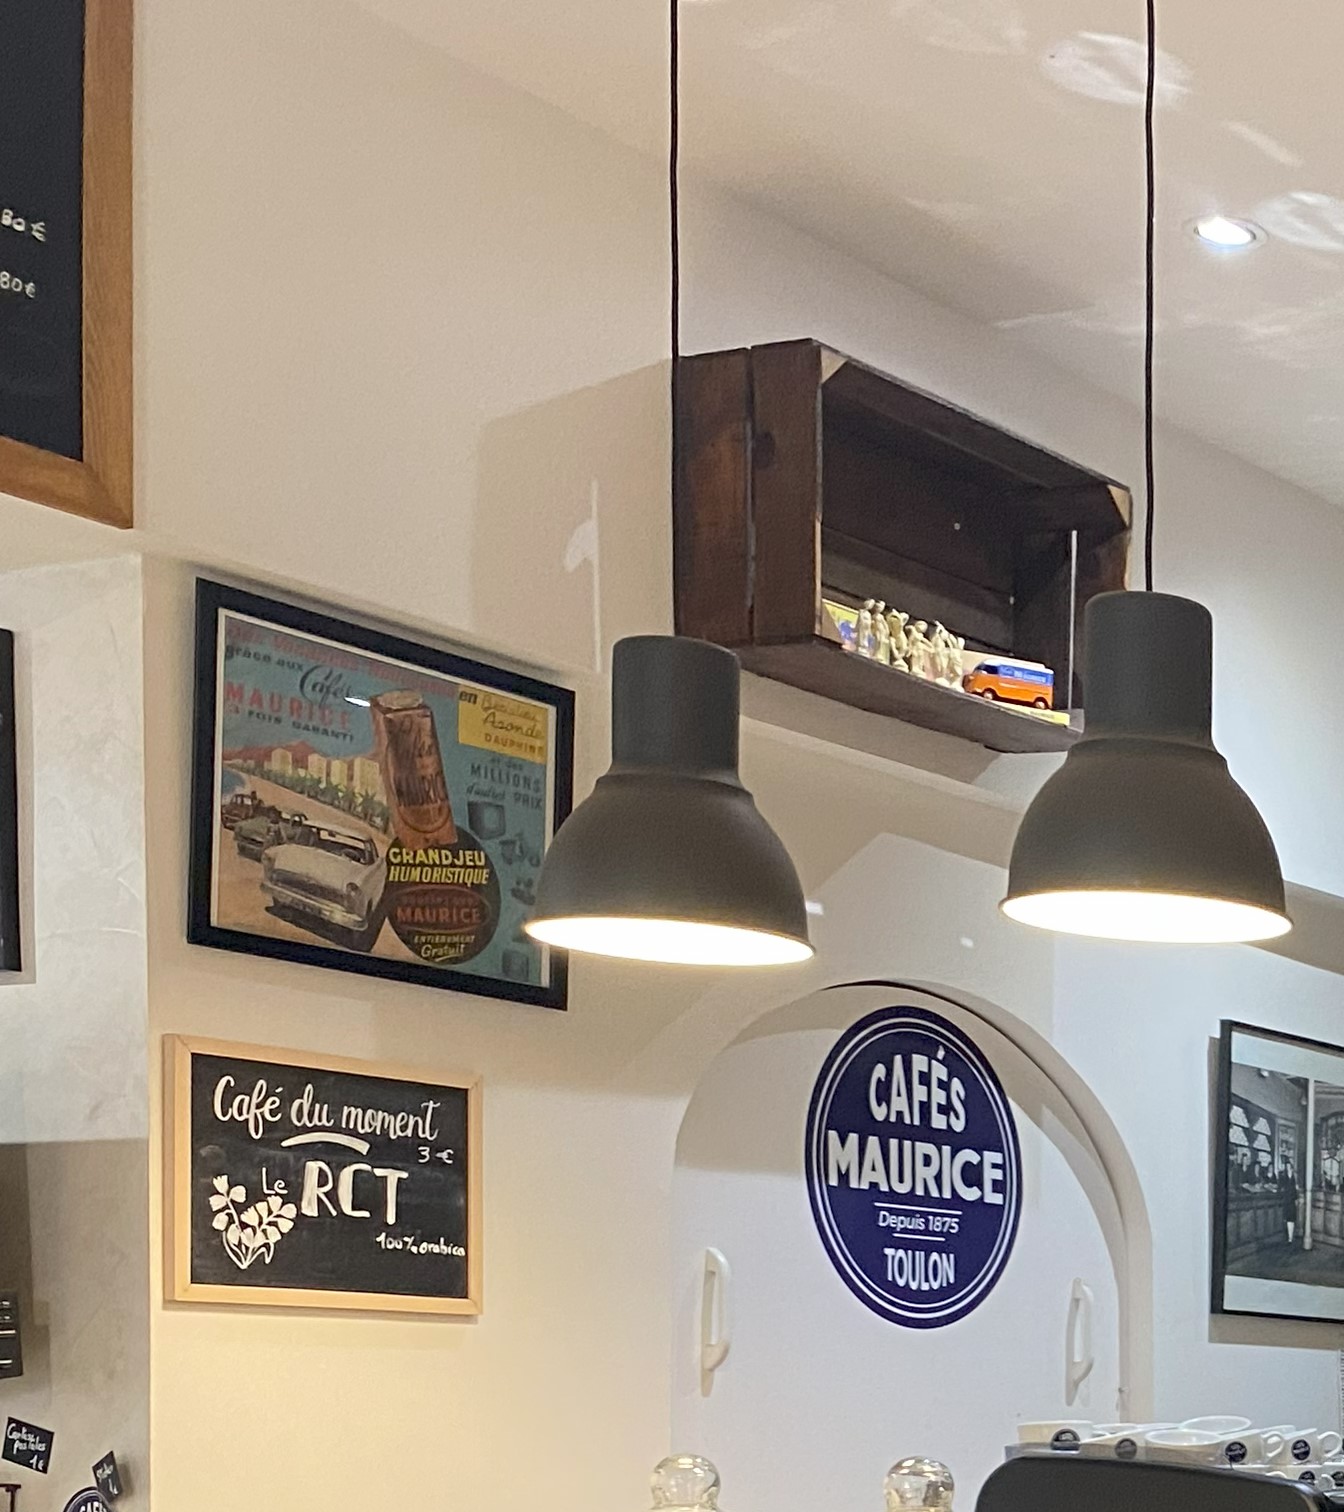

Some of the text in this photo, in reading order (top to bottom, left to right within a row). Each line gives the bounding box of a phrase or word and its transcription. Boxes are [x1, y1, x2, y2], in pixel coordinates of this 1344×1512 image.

[226, 681, 350, 733] MAURICE
[459, 690, 479, 706] en
[470, 761, 542, 793] MILLIONS
[388, 865, 490, 888] HUMORISTIQUE
[396, 906, 481, 923] MAURICE
[213, 1075, 441, 1141] Café du moment
[869, 1045, 966, 1133] CAFÉS
[827, 1129, 1005, 1206] MAURICE
[261, 1159, 409, 1226] Le RCT
[878, 1210, 960, 1234] Depuis 1875
[883, 1247, 955, 1291] TOULON
